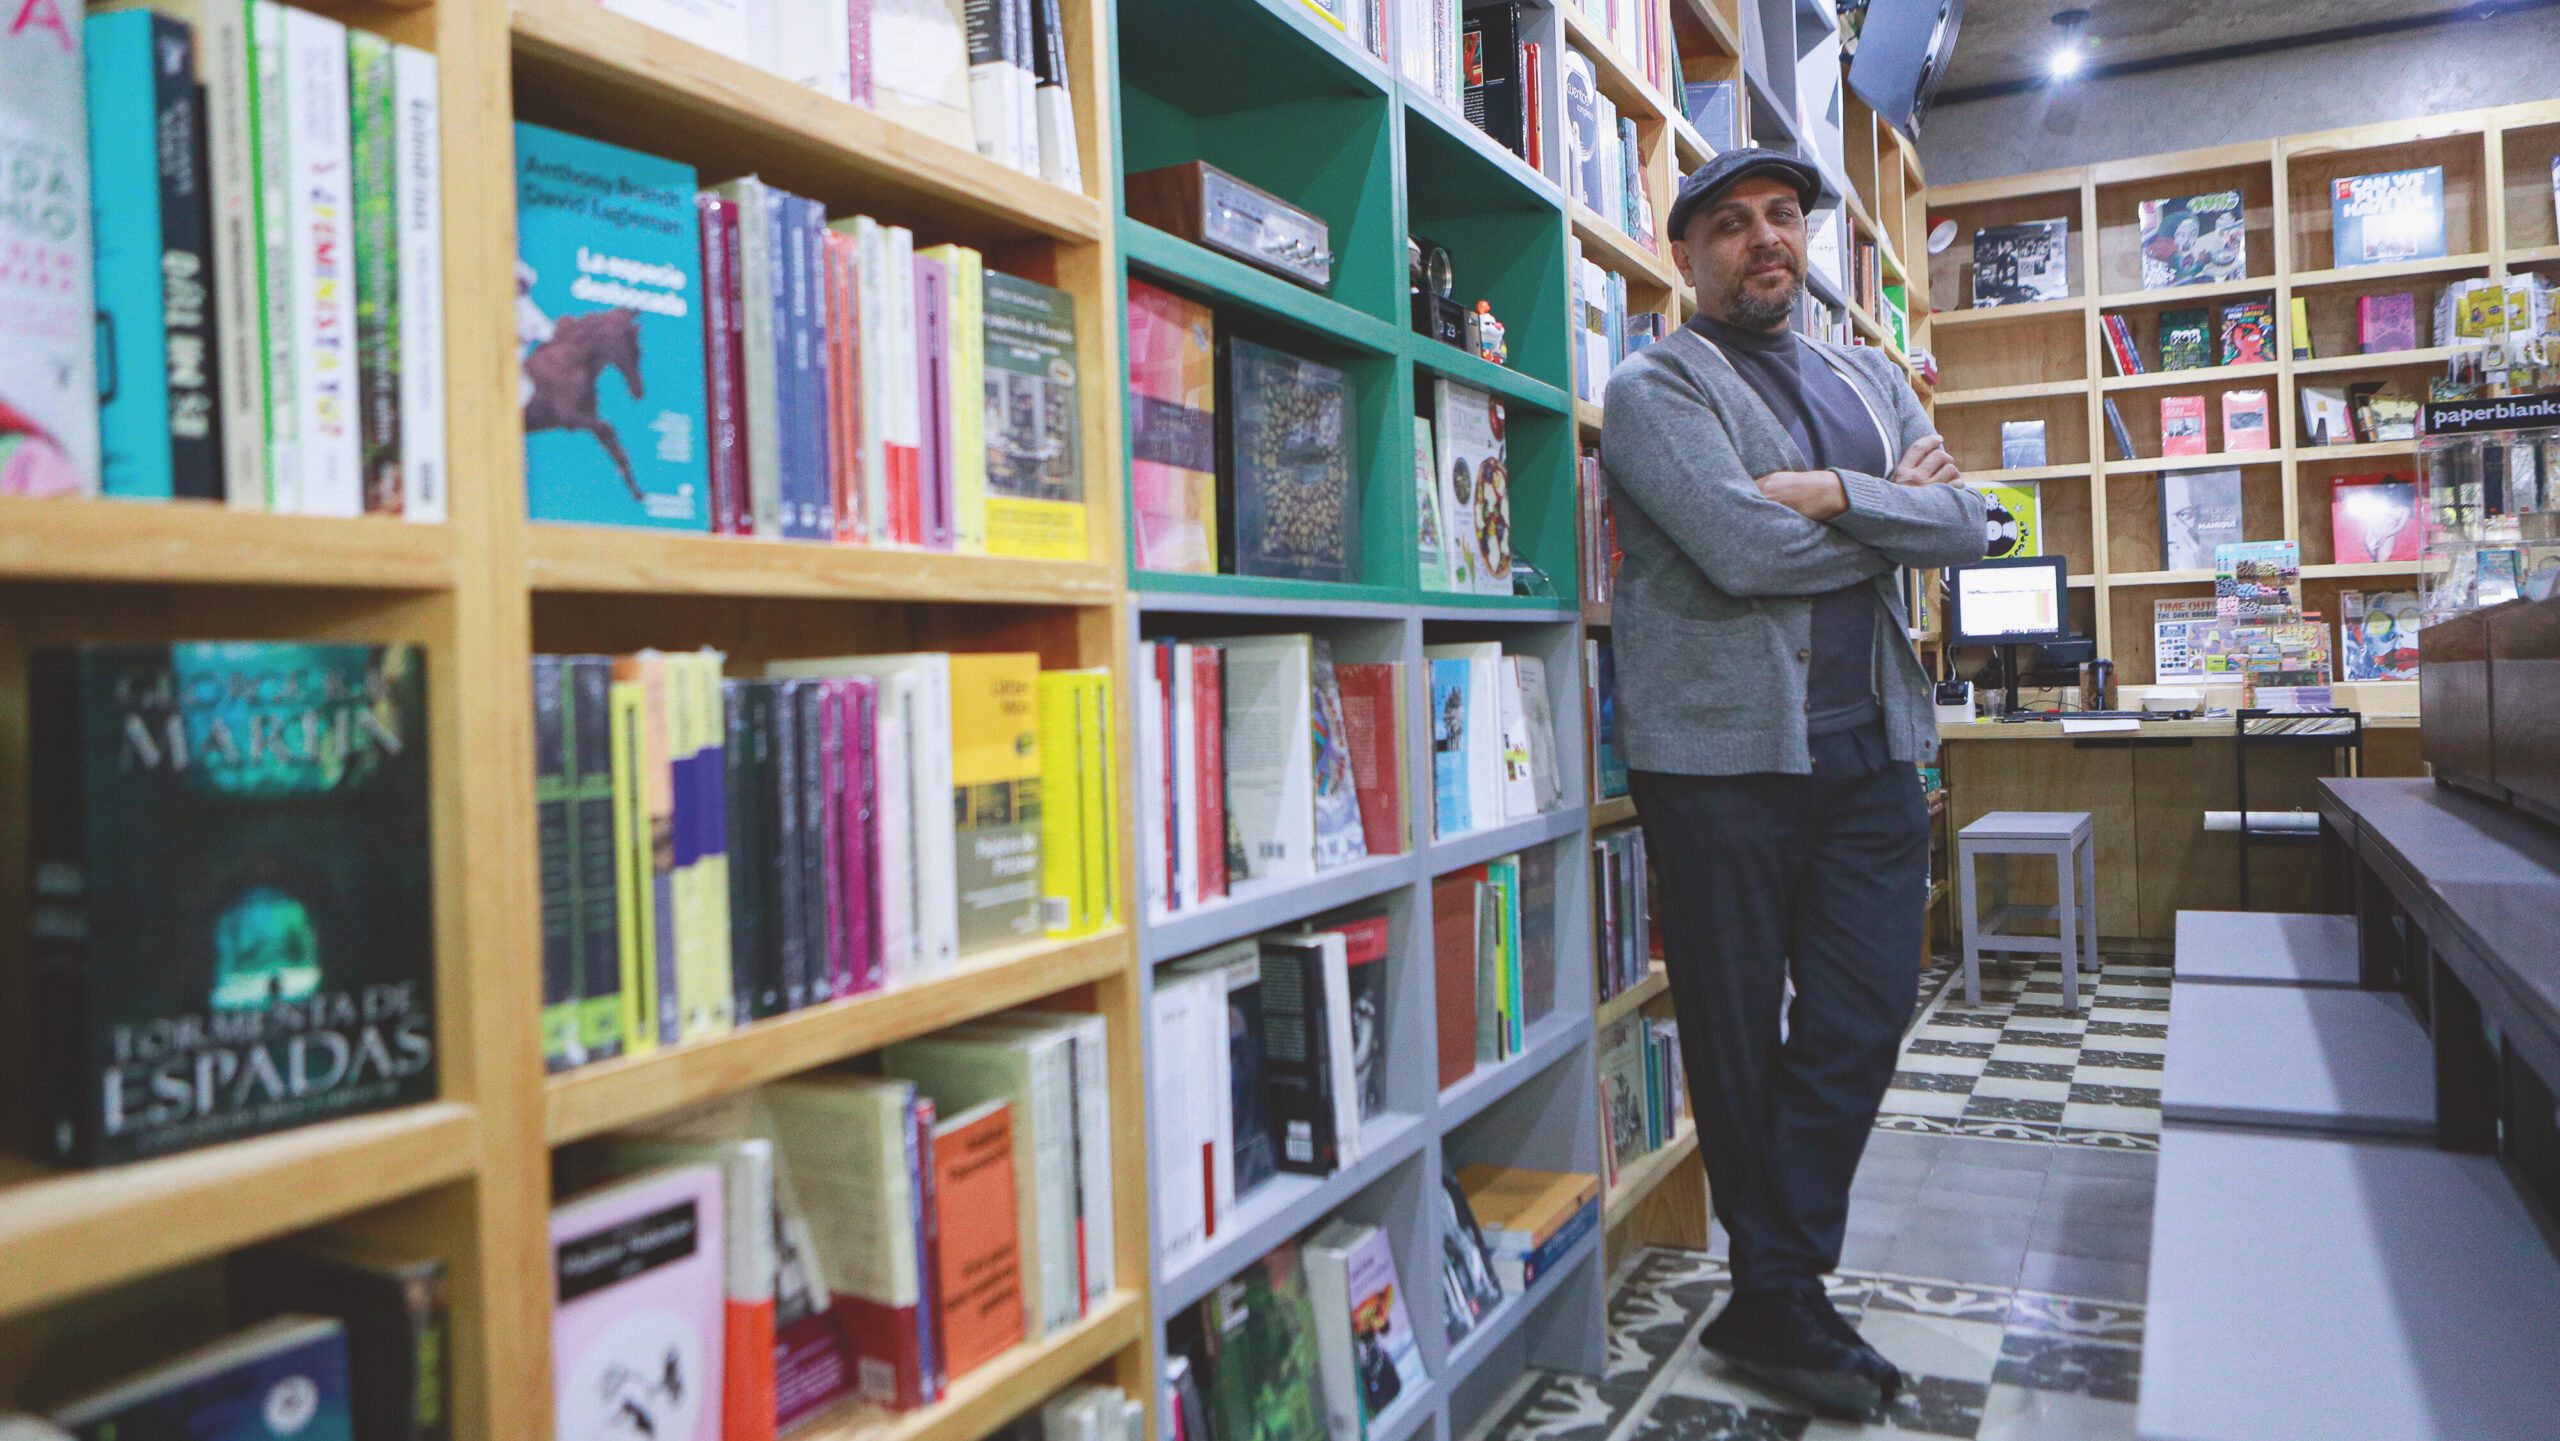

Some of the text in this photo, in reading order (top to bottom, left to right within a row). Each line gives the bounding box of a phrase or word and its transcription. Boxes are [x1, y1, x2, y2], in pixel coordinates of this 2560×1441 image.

[2350, 171, 2425, 193] CAN WE
[2157, 611, 2170, 620] THE
[2172, 611, 2190, 619] DAVE
[2158, 601, 2213, 612] TIME OUT
[121, 703, 402, 770] MARTIN
[112, 980, 415, 1060] TORMENTA DE
[102, 1012, 433, 1137] ESPADAS
